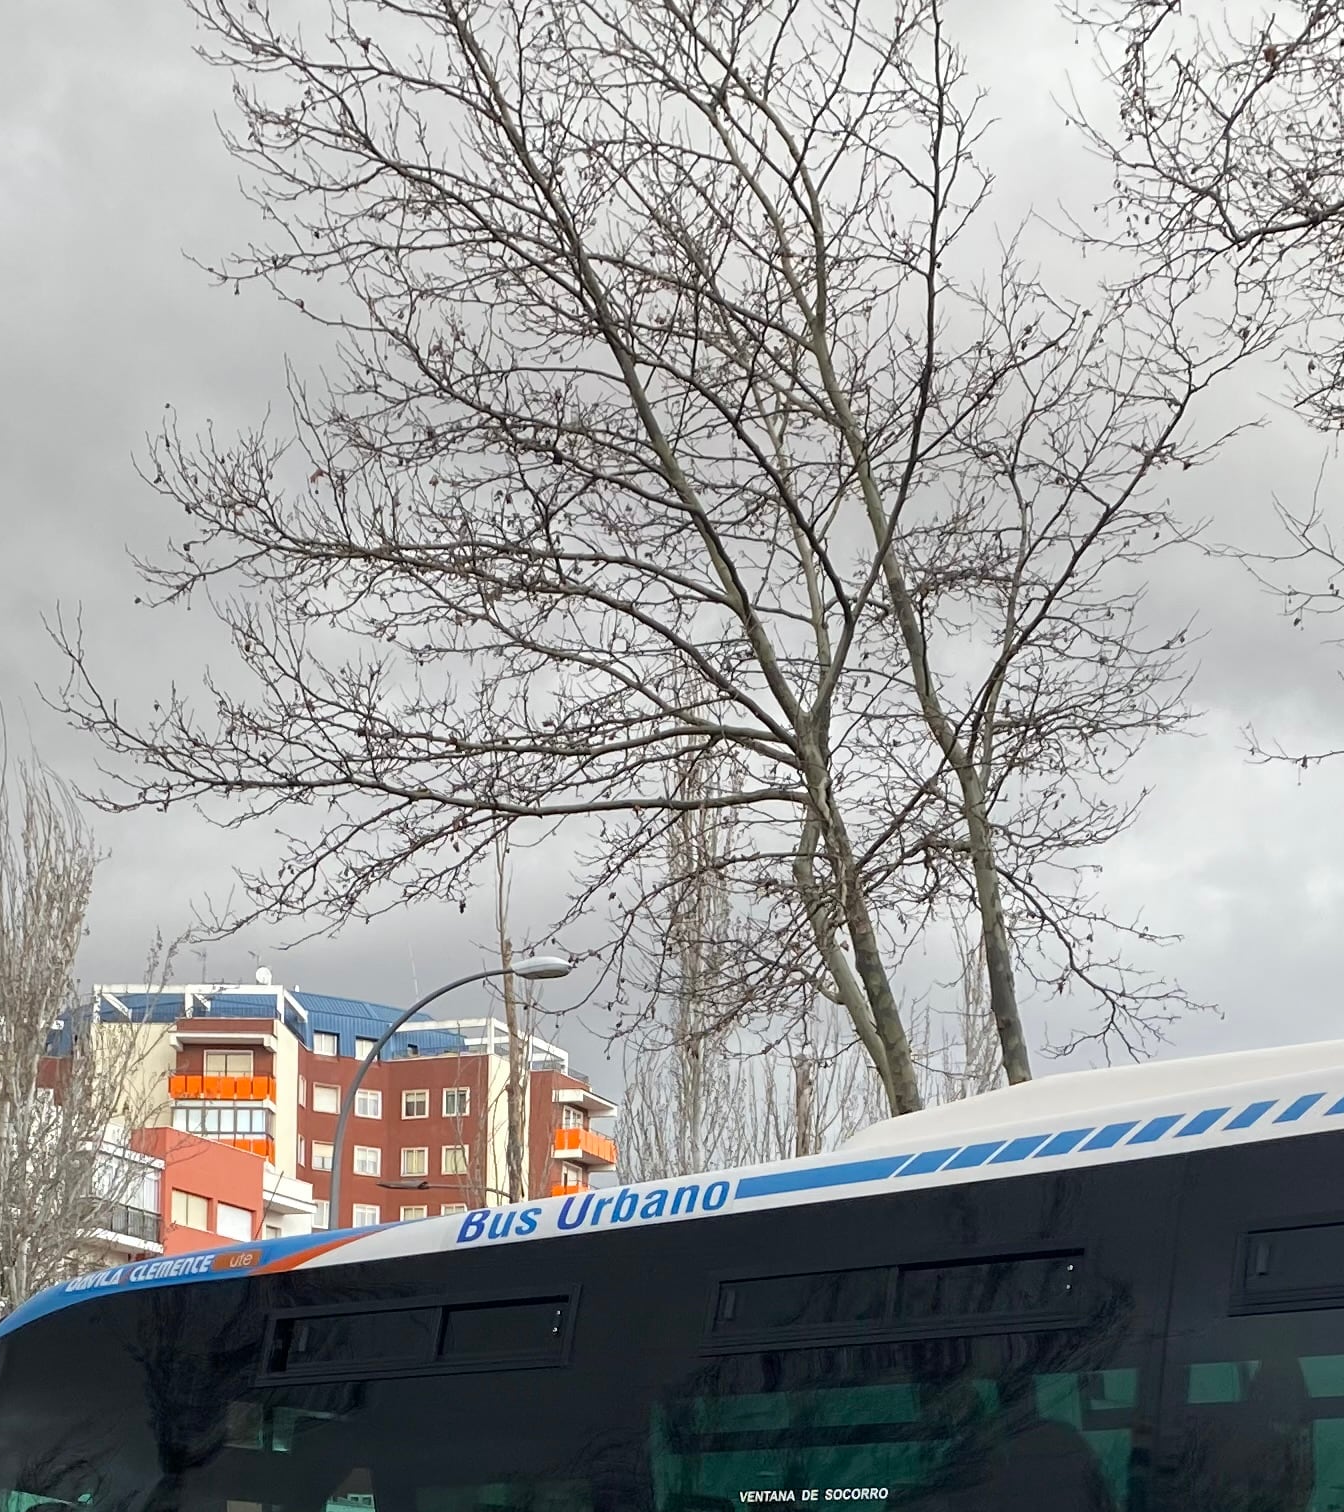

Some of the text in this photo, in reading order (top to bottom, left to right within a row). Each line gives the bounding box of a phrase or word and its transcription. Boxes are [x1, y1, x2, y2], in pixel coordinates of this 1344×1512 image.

[456, 1180, 730, 1244] Bus Urbano
[129, 1254, 214, 1283] CLEMENCE
[229, 1252, 253, 1267] ute
[739, 1487, 889, 1503] VENTANA DE SOCORRO
